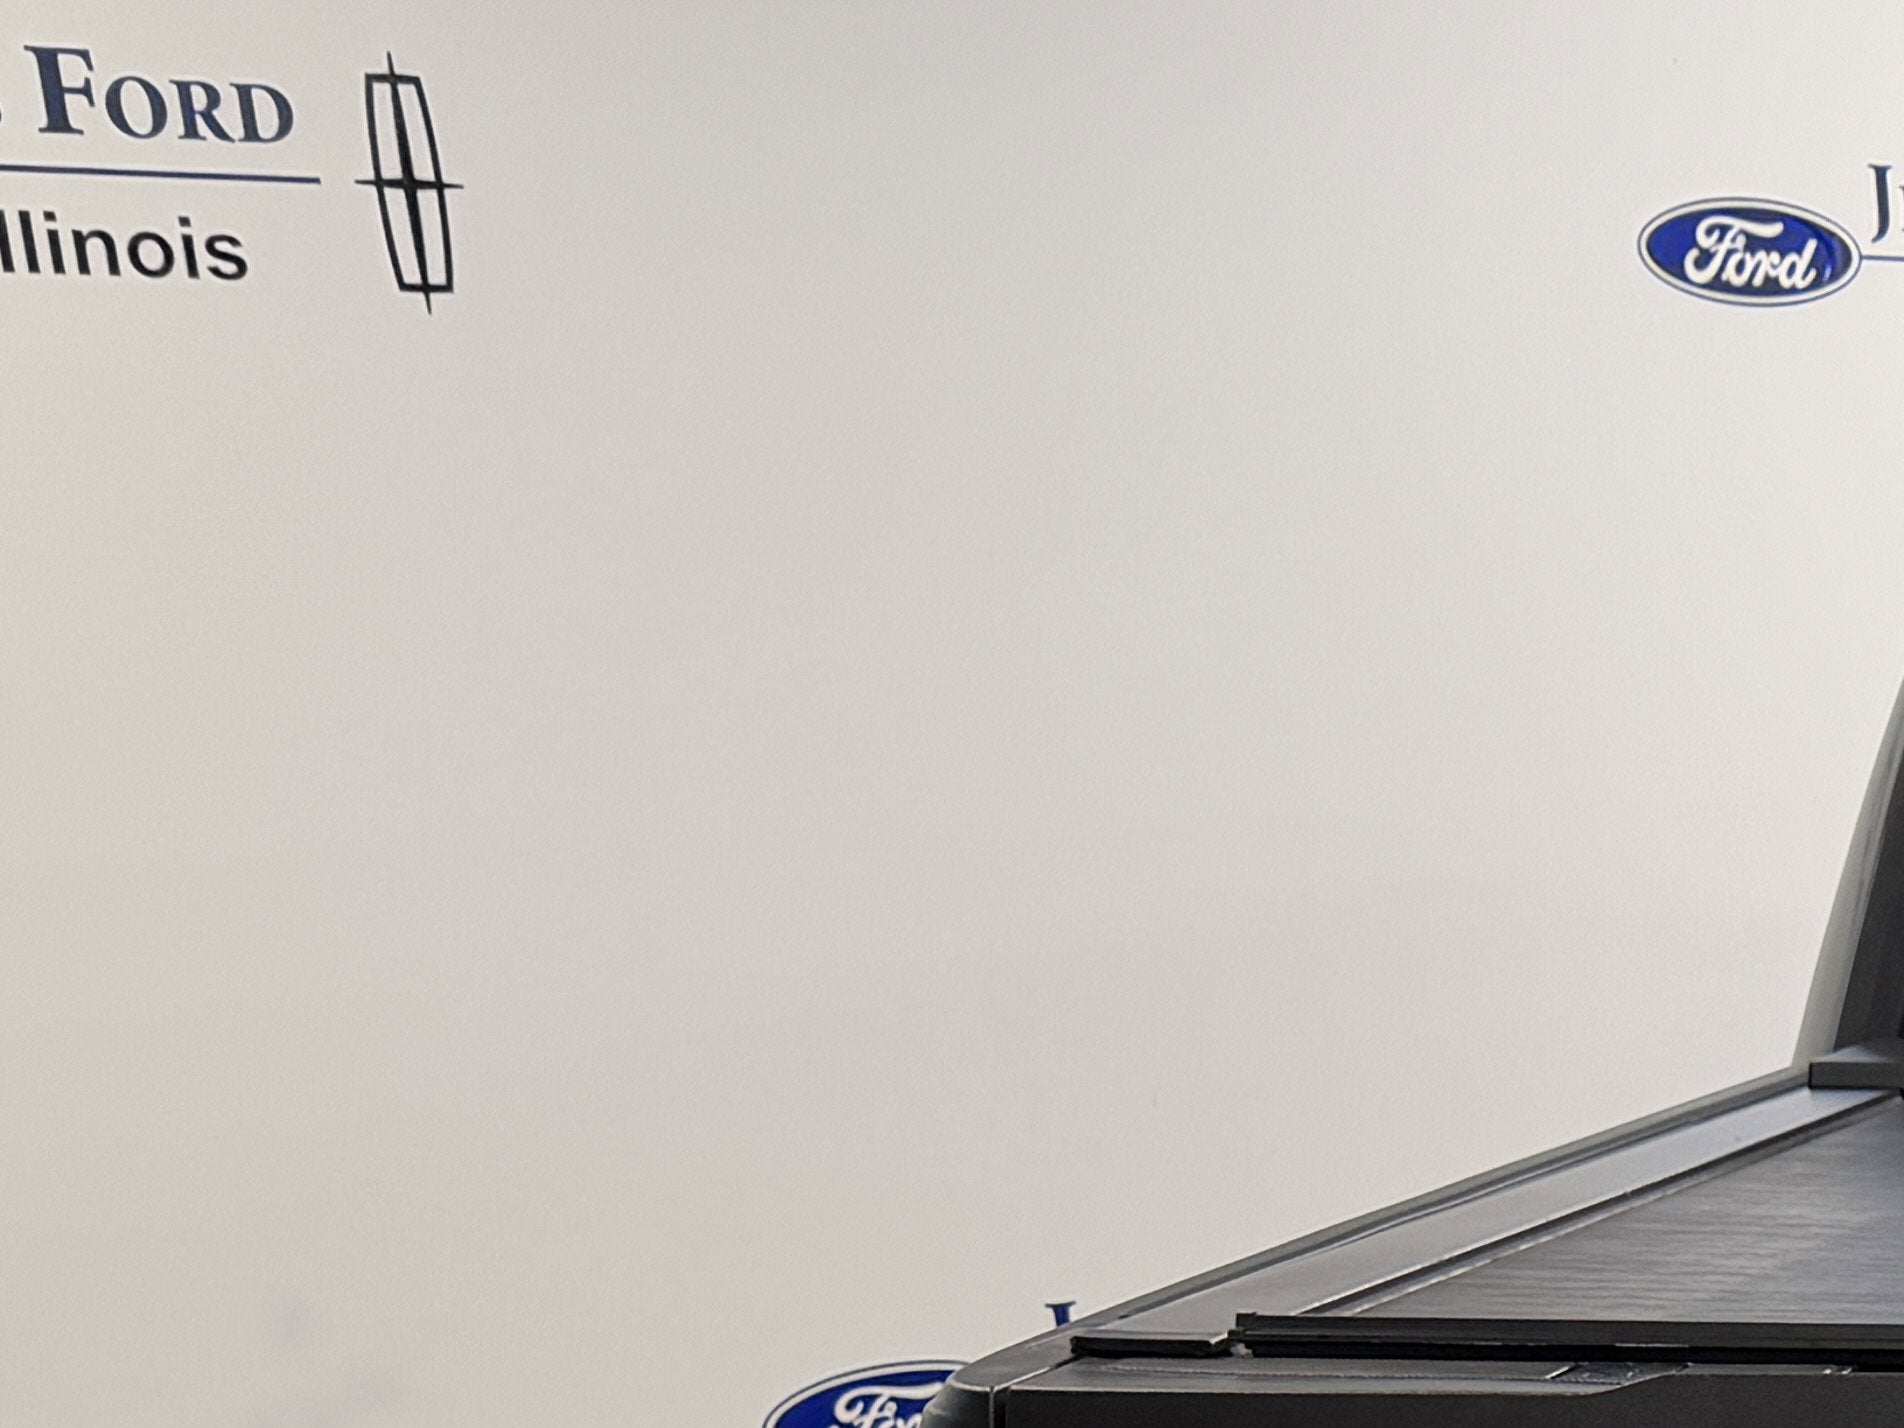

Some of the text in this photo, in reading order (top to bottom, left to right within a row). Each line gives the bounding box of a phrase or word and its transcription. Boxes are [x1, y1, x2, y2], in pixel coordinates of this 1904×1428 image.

[24, 45, 293, 143] FORD
[0, 210, 247, 280] llinois
[1683, 214, 1818, 290] Ford
